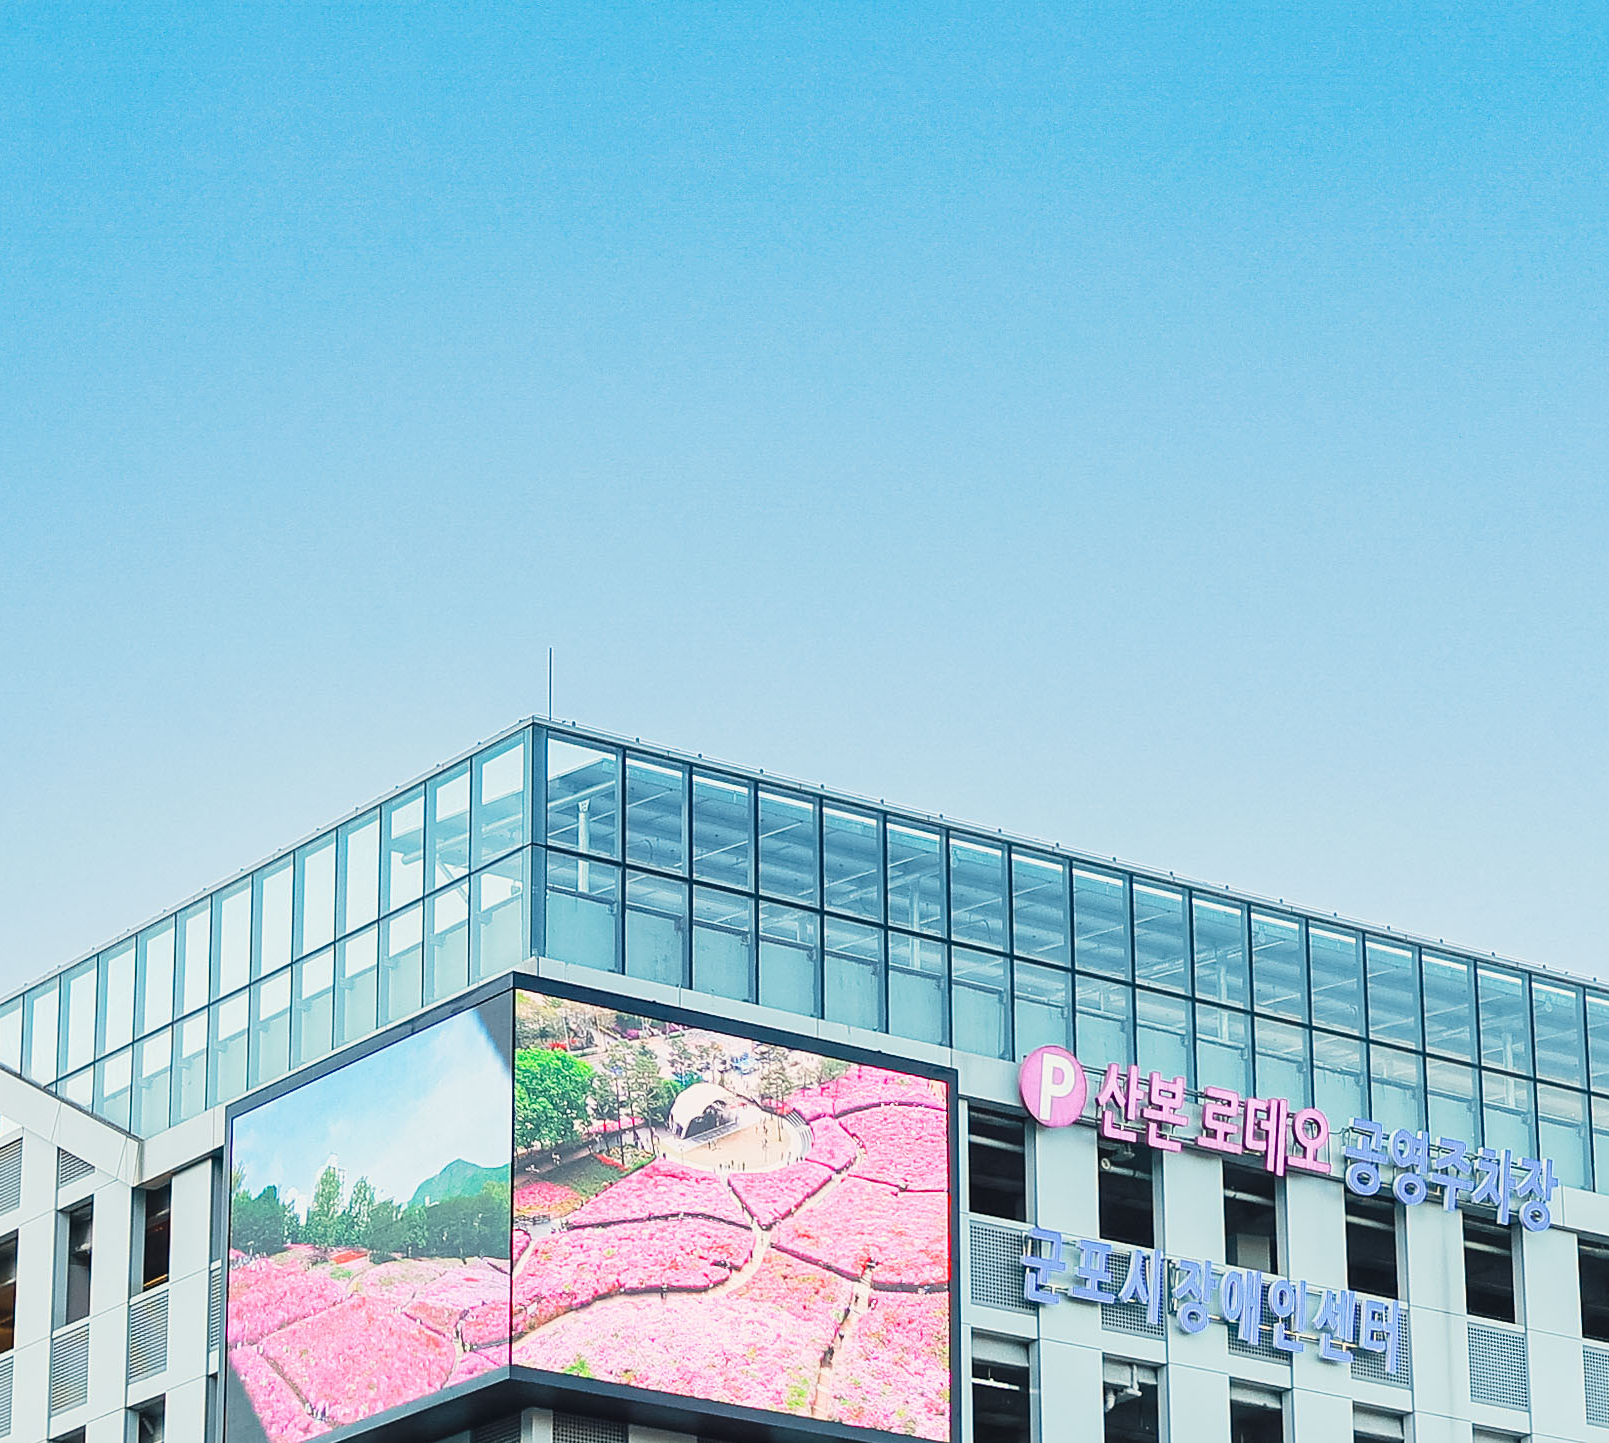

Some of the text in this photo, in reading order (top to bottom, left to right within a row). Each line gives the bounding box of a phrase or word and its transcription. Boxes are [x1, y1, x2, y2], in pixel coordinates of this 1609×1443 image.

[1095, 1062, 1189, 1152] 산본
[1196, 1085, 1331, 1177] 로데오
[1343, 1117, 1558, 1232] 공영주차장
